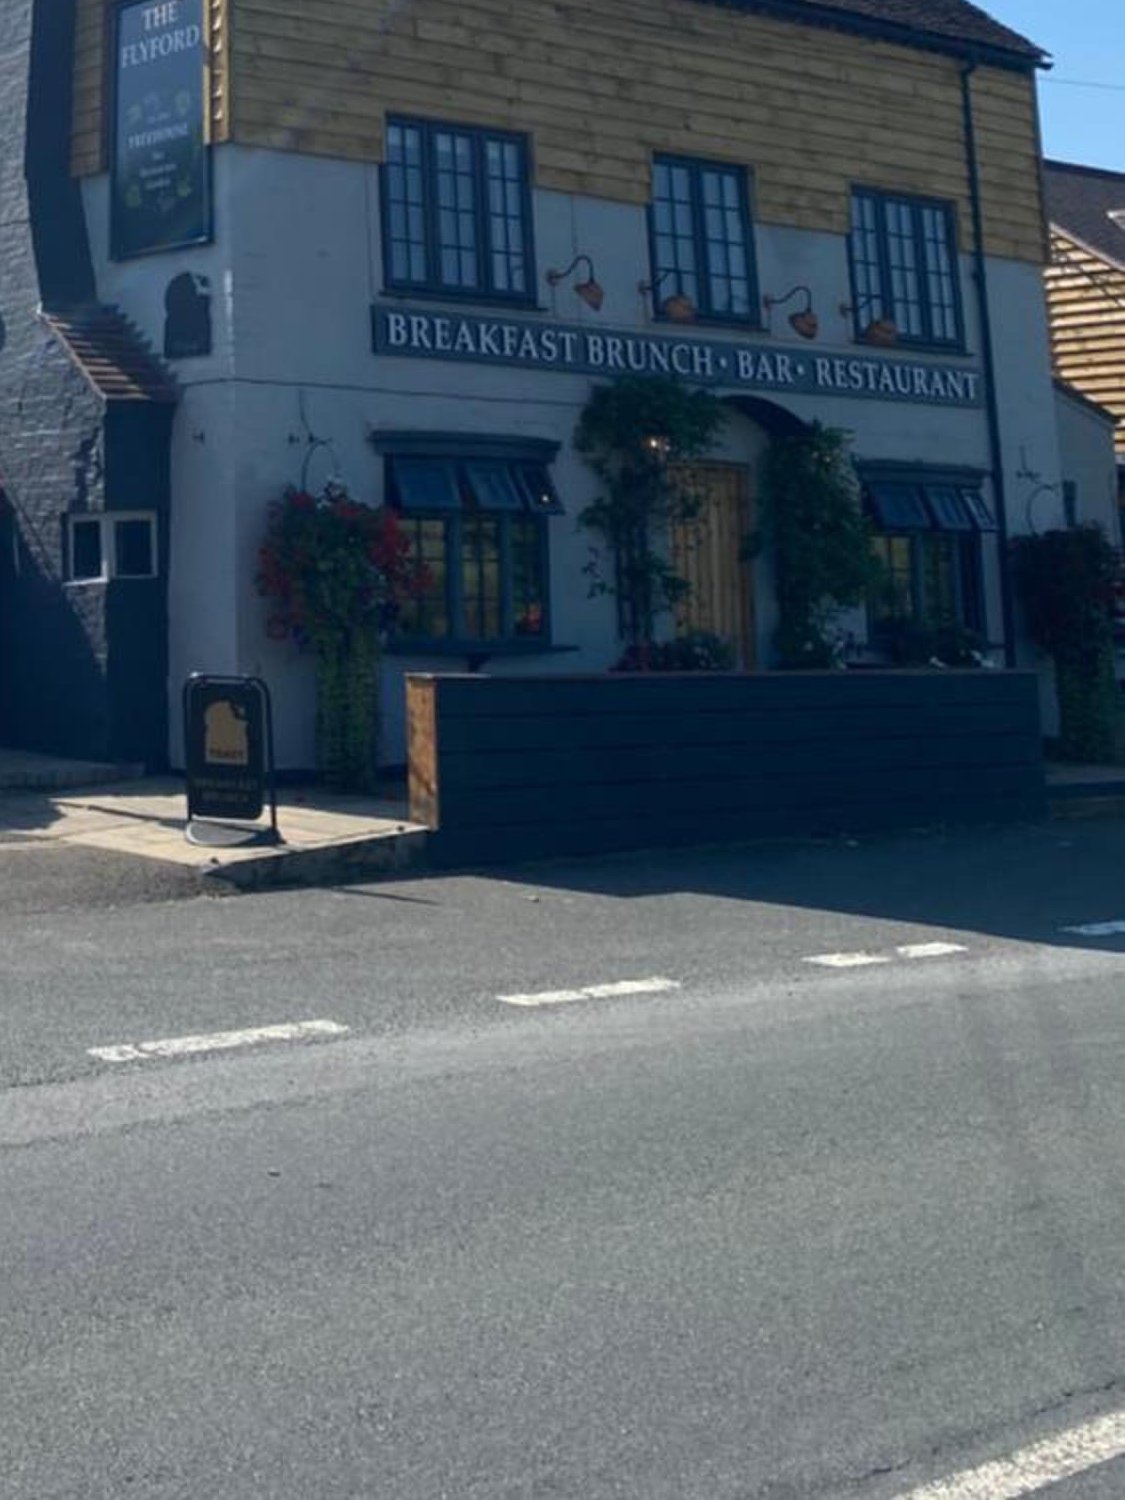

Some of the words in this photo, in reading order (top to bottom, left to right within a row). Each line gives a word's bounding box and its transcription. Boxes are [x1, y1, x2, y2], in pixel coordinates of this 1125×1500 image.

[143, 1, 178, 31] THE
[121, 24, 200, 69] FLYFORD
[387, 313, 578, 365] BREAKFAST
[586, 334, 715, 378] BRUNCH
[738, 350, 795, 384] BAR
[816, 360, 978, 400] RESTAURANT
